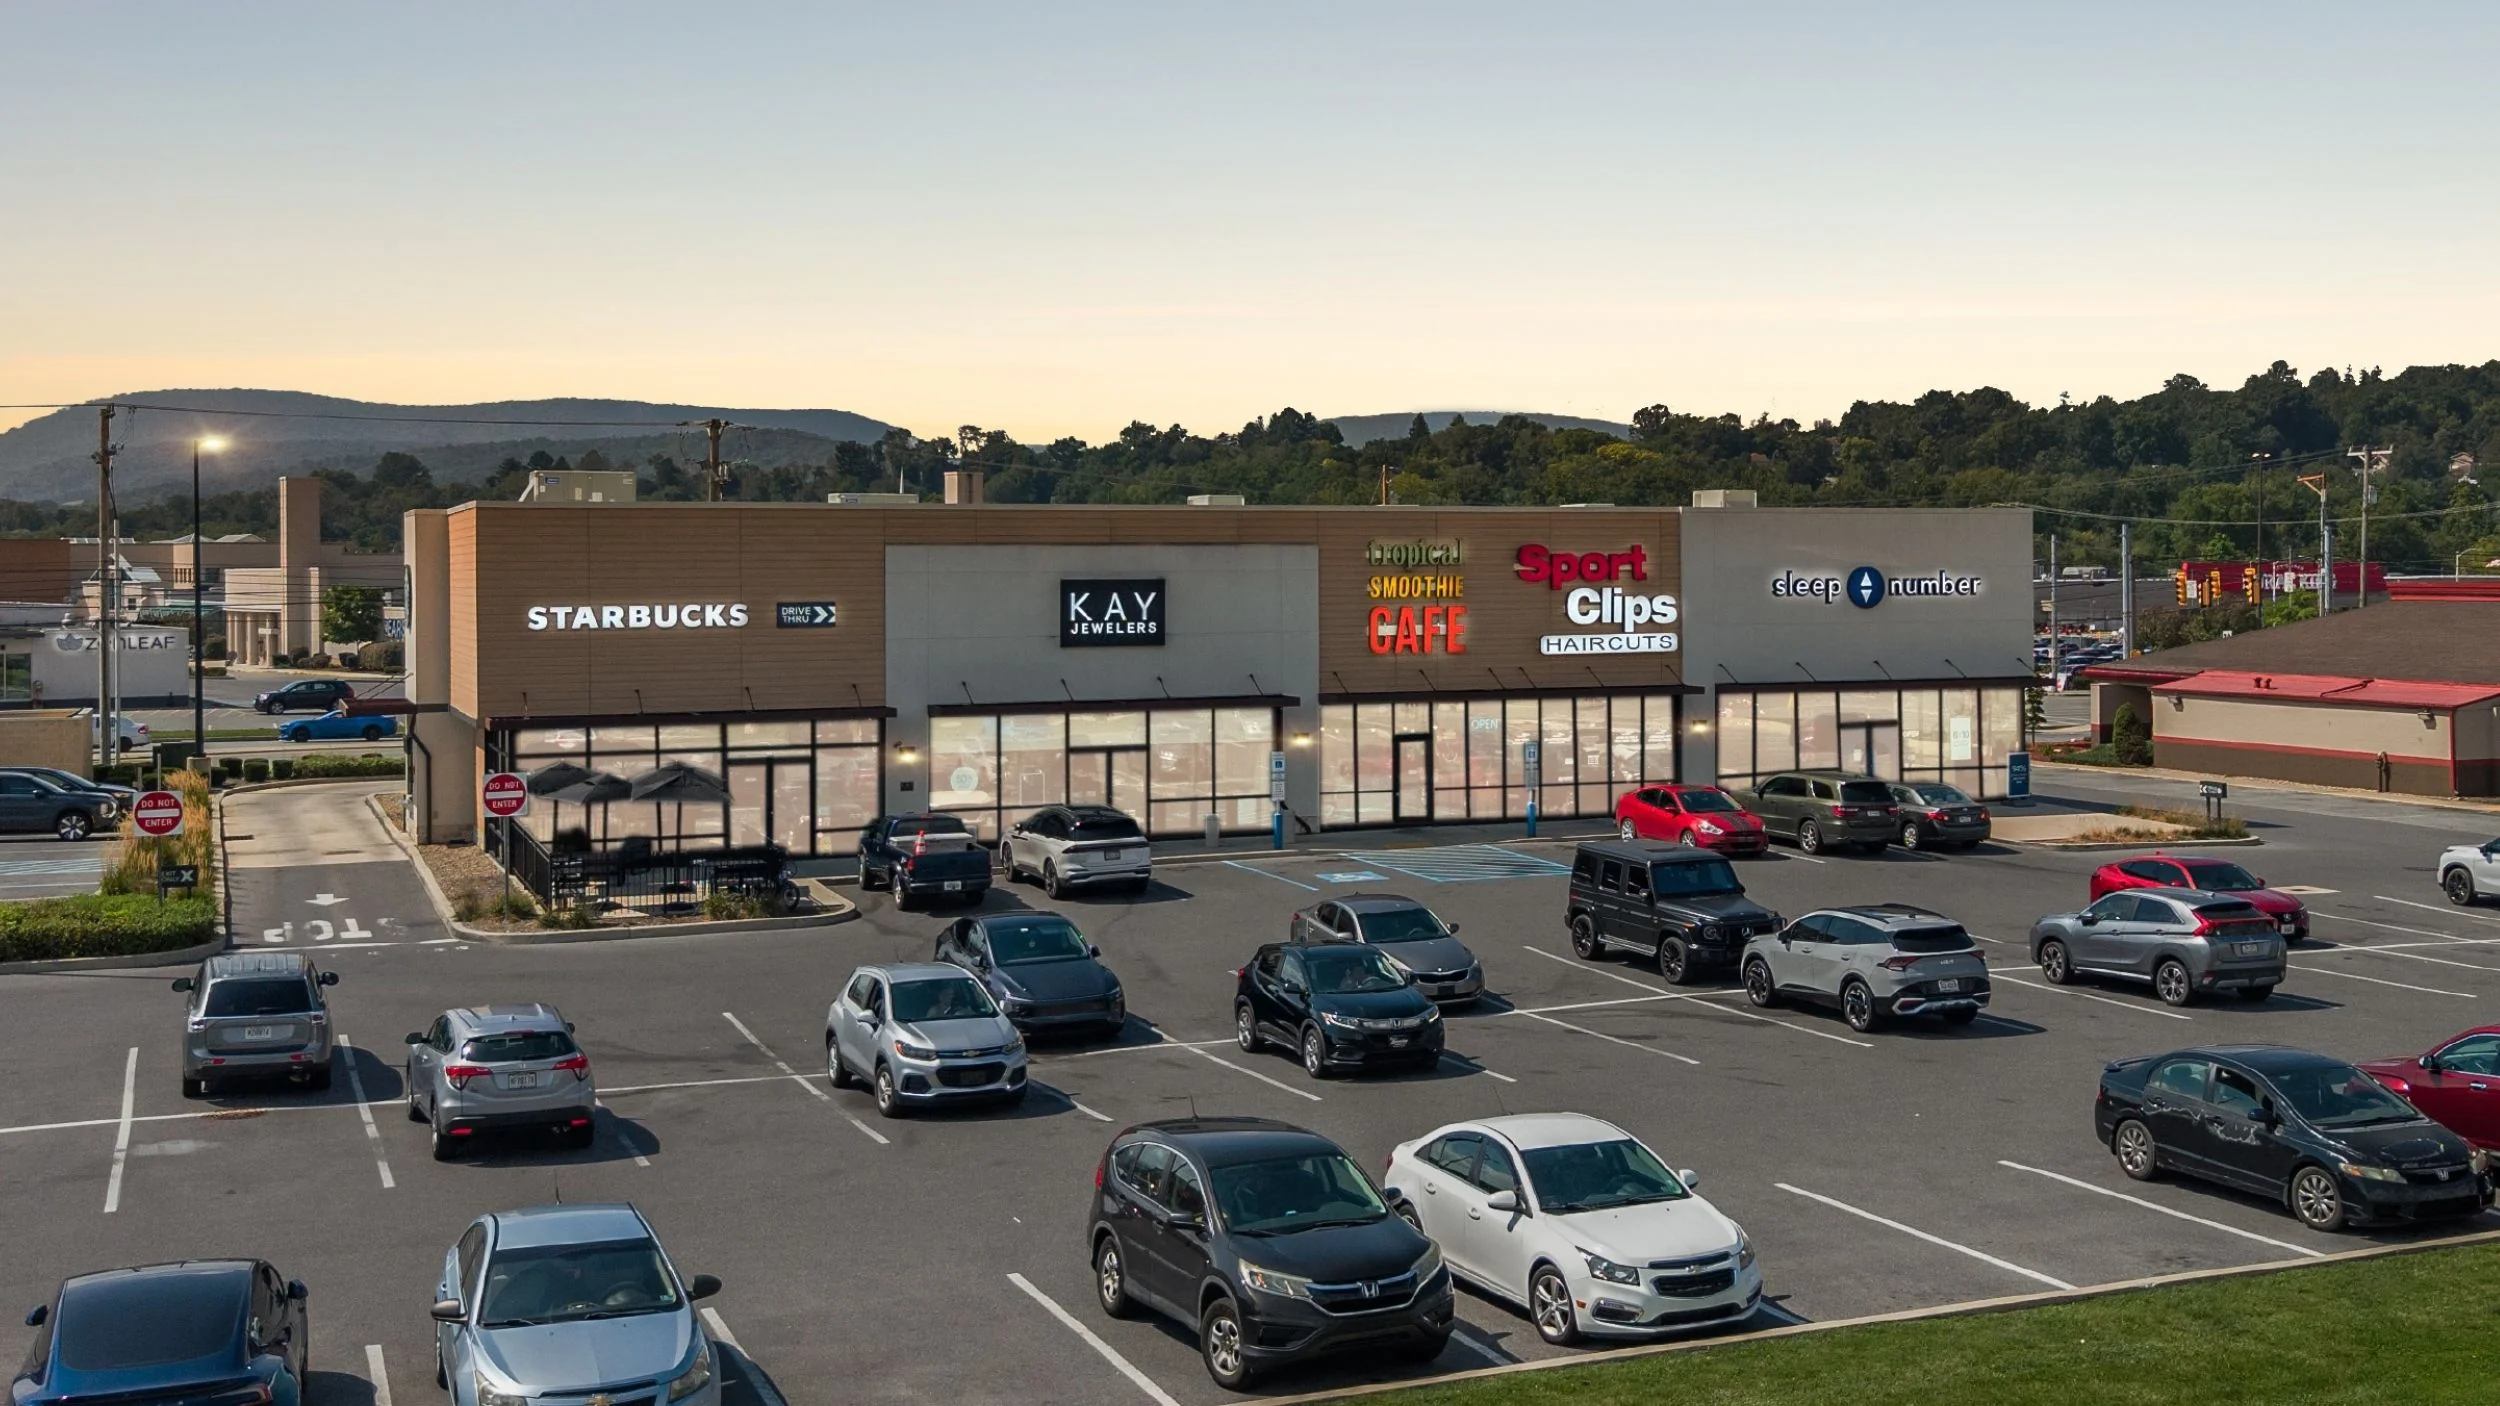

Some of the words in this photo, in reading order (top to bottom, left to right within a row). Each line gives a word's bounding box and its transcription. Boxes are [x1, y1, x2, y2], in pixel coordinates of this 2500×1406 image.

[1368, 538, 1464, 568] tropical
[1516, 544, 1648, 590] Sport
[1368, 575, 1464, 599] SMOOTHIE
[1772, 570, 1842, 604] sleep
[1888, 569, 1982, 596] number
[781, 606, 811, 616] DRIVE
[1069, 591, 1157, 621] KAY
[1566, 587, 1678, 633] Clips
[527, 603, 749, 630] STARBUCKS
[782, 615, 810, 624] THRU
[1070, 622, 1157, 634] JEWELERS
[1368, 604, 1468, 655] CAFE
[1546, 635, 1674, 652] HAIRCUTS
[1471, 719, 1498, 730] OPEN
[489, 782, 500, 790] DO
[504, 781, 519, 789] NOT
[141, 799, 154, 808] DO
[158, 799, 175, 808] NOT
[492, 800, 517, 808] ENTER
[145, 818, 172, 827] ENTER
